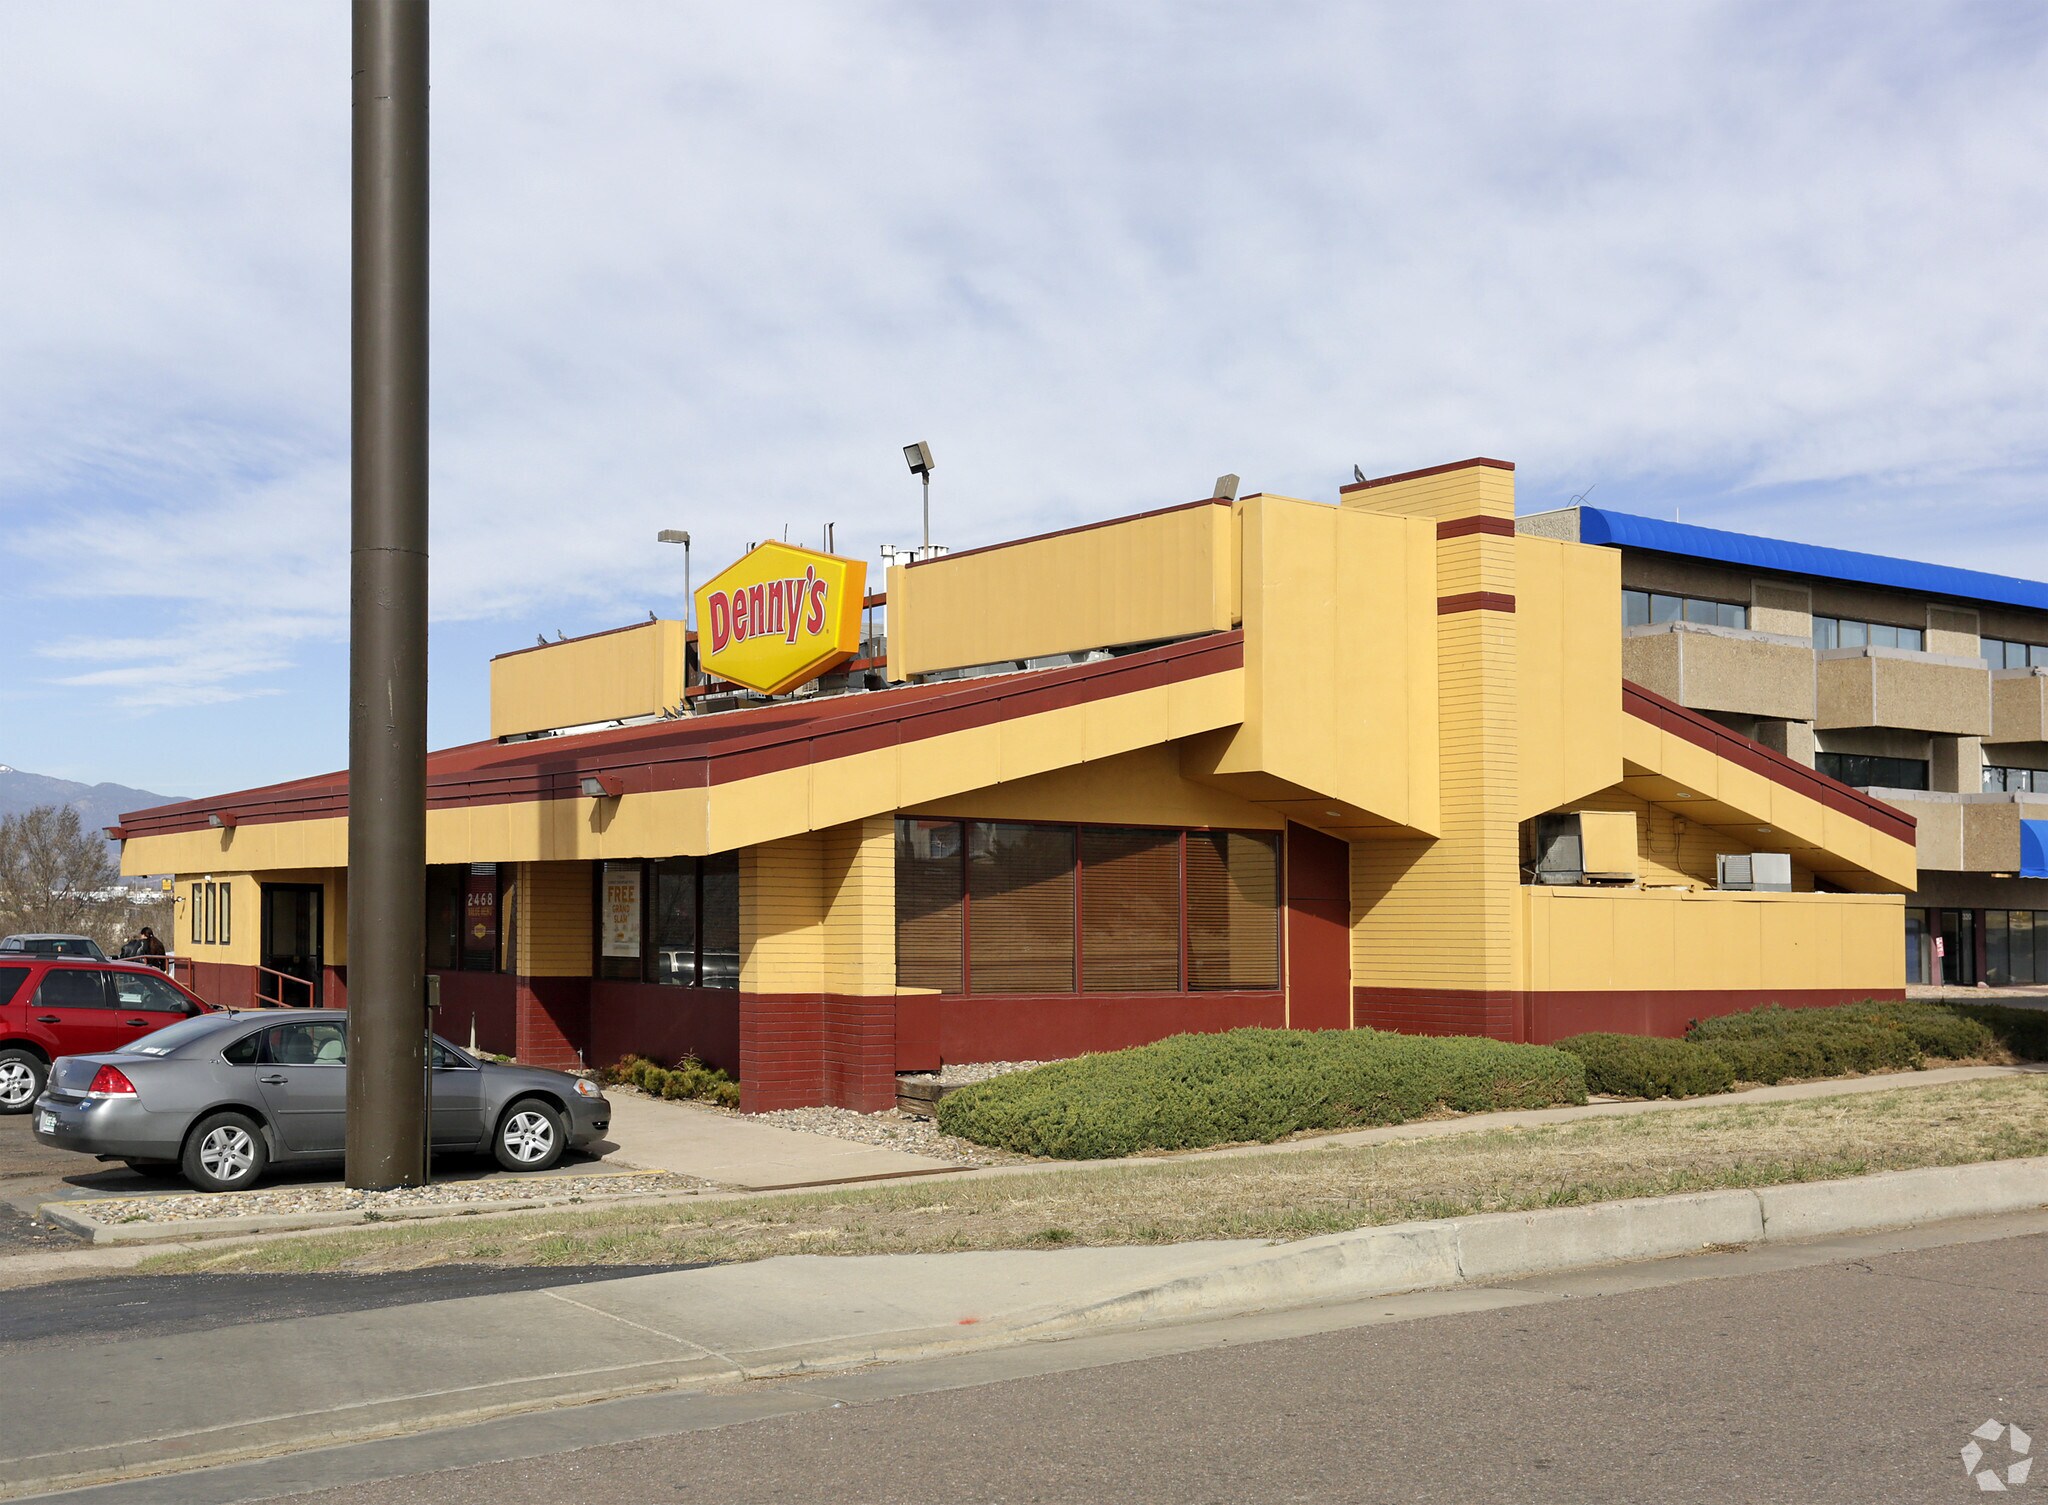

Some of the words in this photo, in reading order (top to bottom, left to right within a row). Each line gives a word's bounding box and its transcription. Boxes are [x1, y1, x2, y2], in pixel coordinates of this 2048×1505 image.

[708, 564, 828, 656] Denny's
[467, 892, 493, 907] 2468
[607, 885, 635, 903] FREE
[612, 904, 631, 913] GRAND
[614, 914, 628, 924] SLAM
